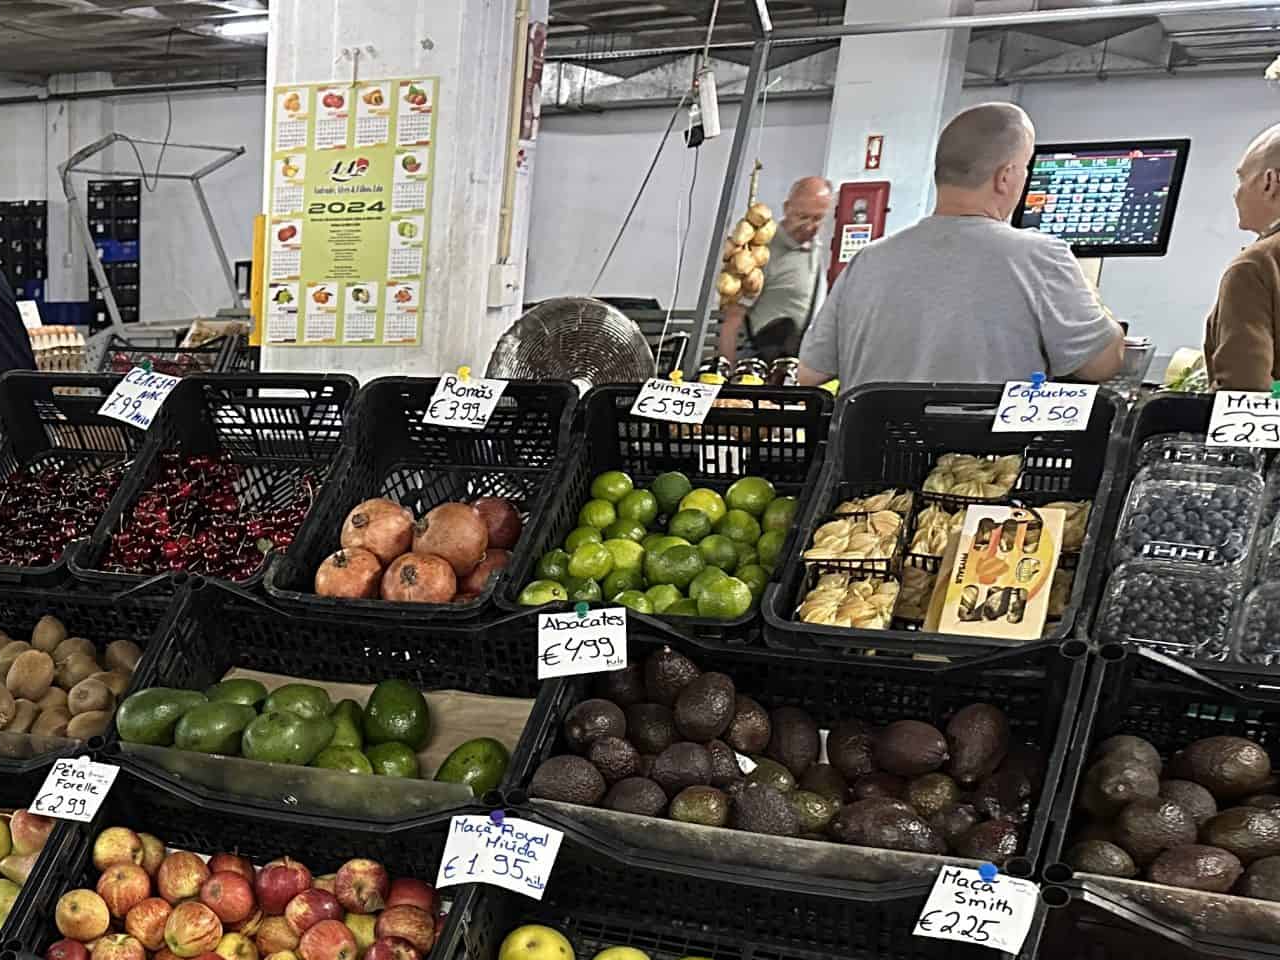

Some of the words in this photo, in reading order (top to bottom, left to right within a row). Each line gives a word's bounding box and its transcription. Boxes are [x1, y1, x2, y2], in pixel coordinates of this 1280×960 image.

[308, 200, 387, 214] 2024
[541, 611, 624, 631] Abacates
[55, 778, 100, 796] Forelle
